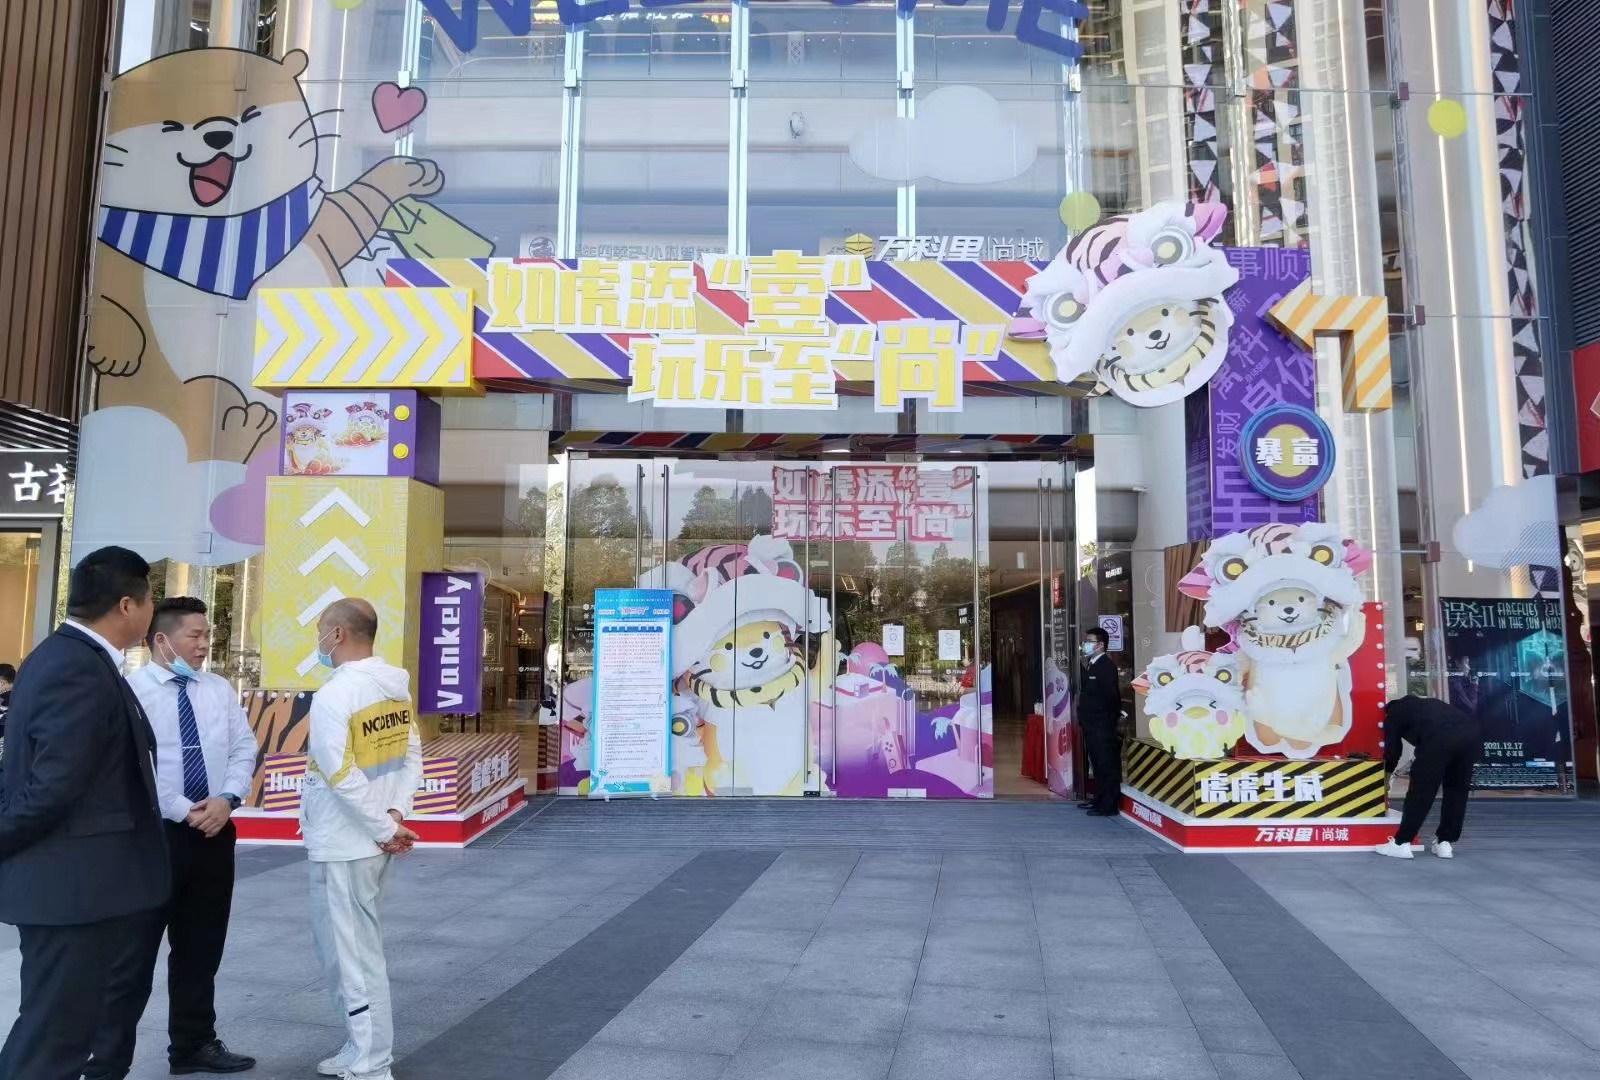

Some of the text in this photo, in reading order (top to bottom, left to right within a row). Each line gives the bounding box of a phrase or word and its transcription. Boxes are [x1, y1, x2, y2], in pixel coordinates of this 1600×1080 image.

[875, 235, 1045, 262] 万科里 尚城
[1256, 437, 1319, 467] 暴富
[1497, 602, 1539, 617] FIREFLIES
[1508, 616, 1525, 630] THE
[1526, 616, 1540, 630] SUN
[433, 575, 472, 709] Vankely
[1483, 741, 1524, 751] 2021.12.17
[270, 772, 450, 793] Hap ear
[1201, 769, 1323, 803] 虎虎生威
[1255, 827, 1349, 843] 万科里 尚城
